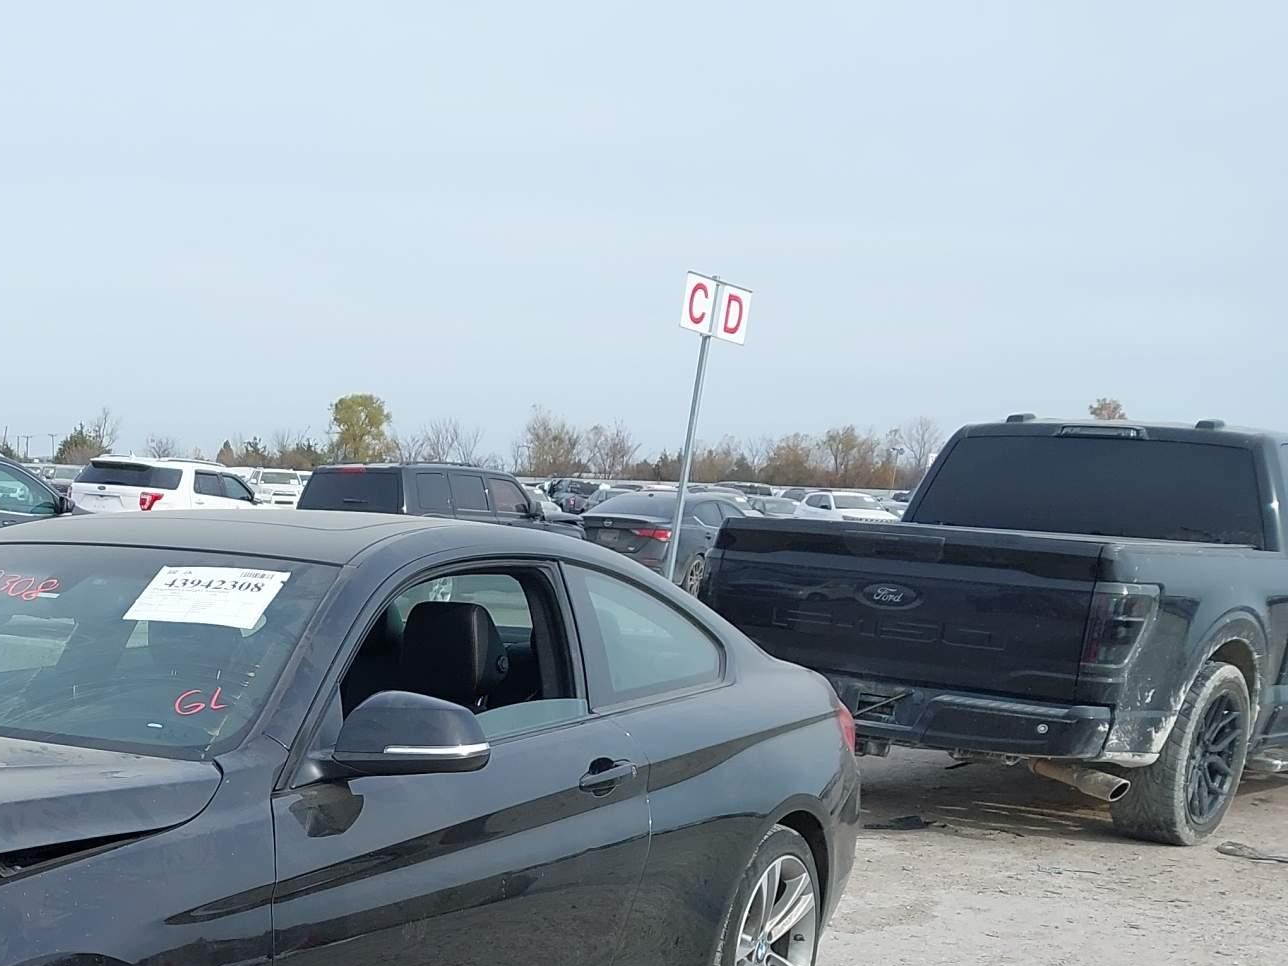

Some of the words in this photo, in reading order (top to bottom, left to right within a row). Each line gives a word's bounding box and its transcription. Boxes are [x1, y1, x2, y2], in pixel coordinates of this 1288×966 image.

[689, 283, 709, 324] C
[724, 293, 743, 334] D
[164, 578, 264, 593] 43942308
[873, 587, 904, 602] Ford
[175, 686, 229, 715] GL
